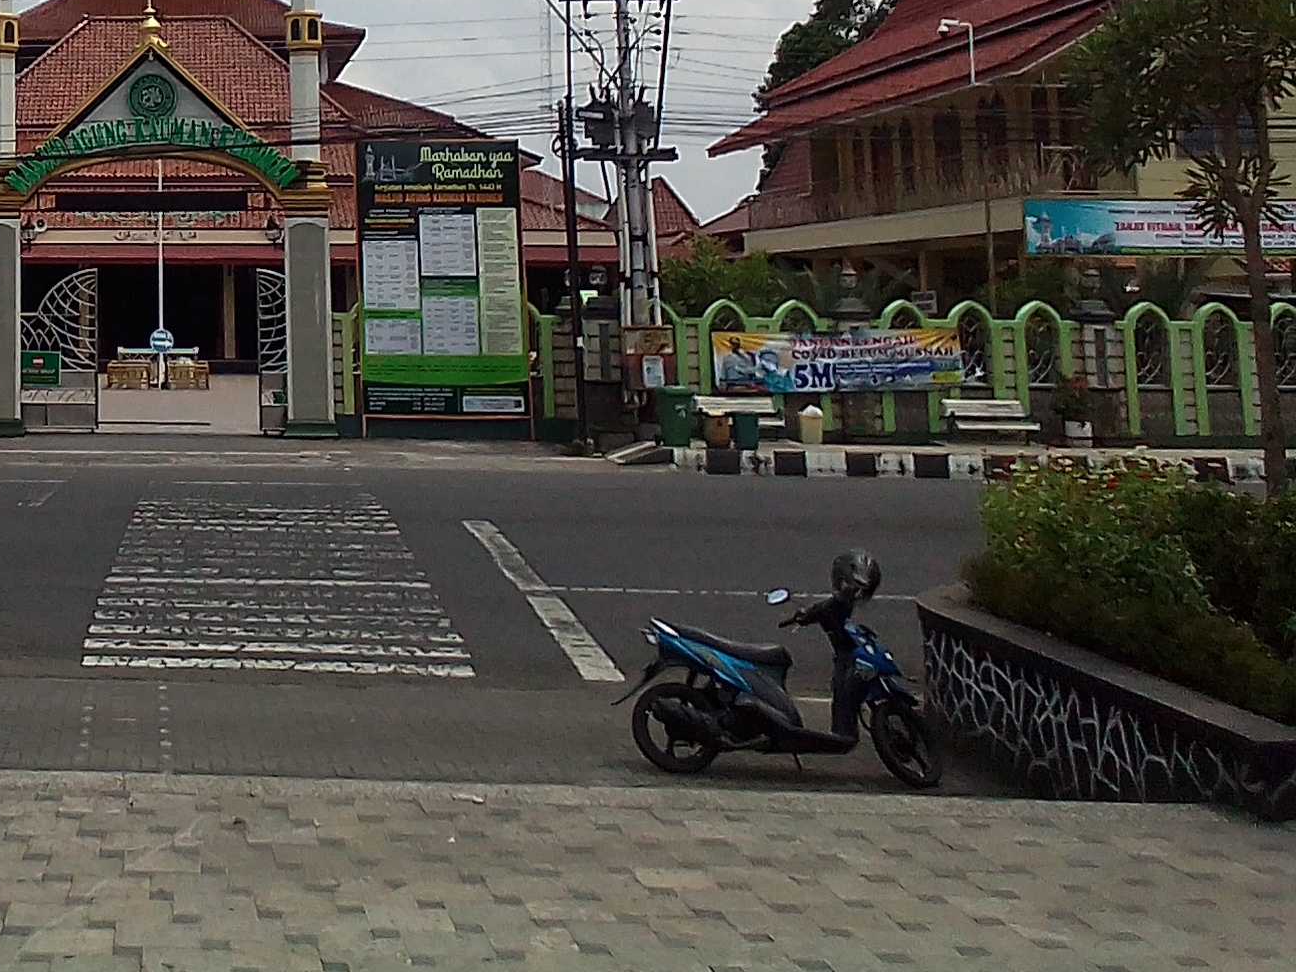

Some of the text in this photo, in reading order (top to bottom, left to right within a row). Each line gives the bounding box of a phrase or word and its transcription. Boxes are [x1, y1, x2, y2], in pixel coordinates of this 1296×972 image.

[68, 118, 128, 154] AGUNG
[420, 146, 515, 168] Marhaban yaa
[431, 164, 504, 181] Ramadhan
[795, 362, 835, 389] 5M
